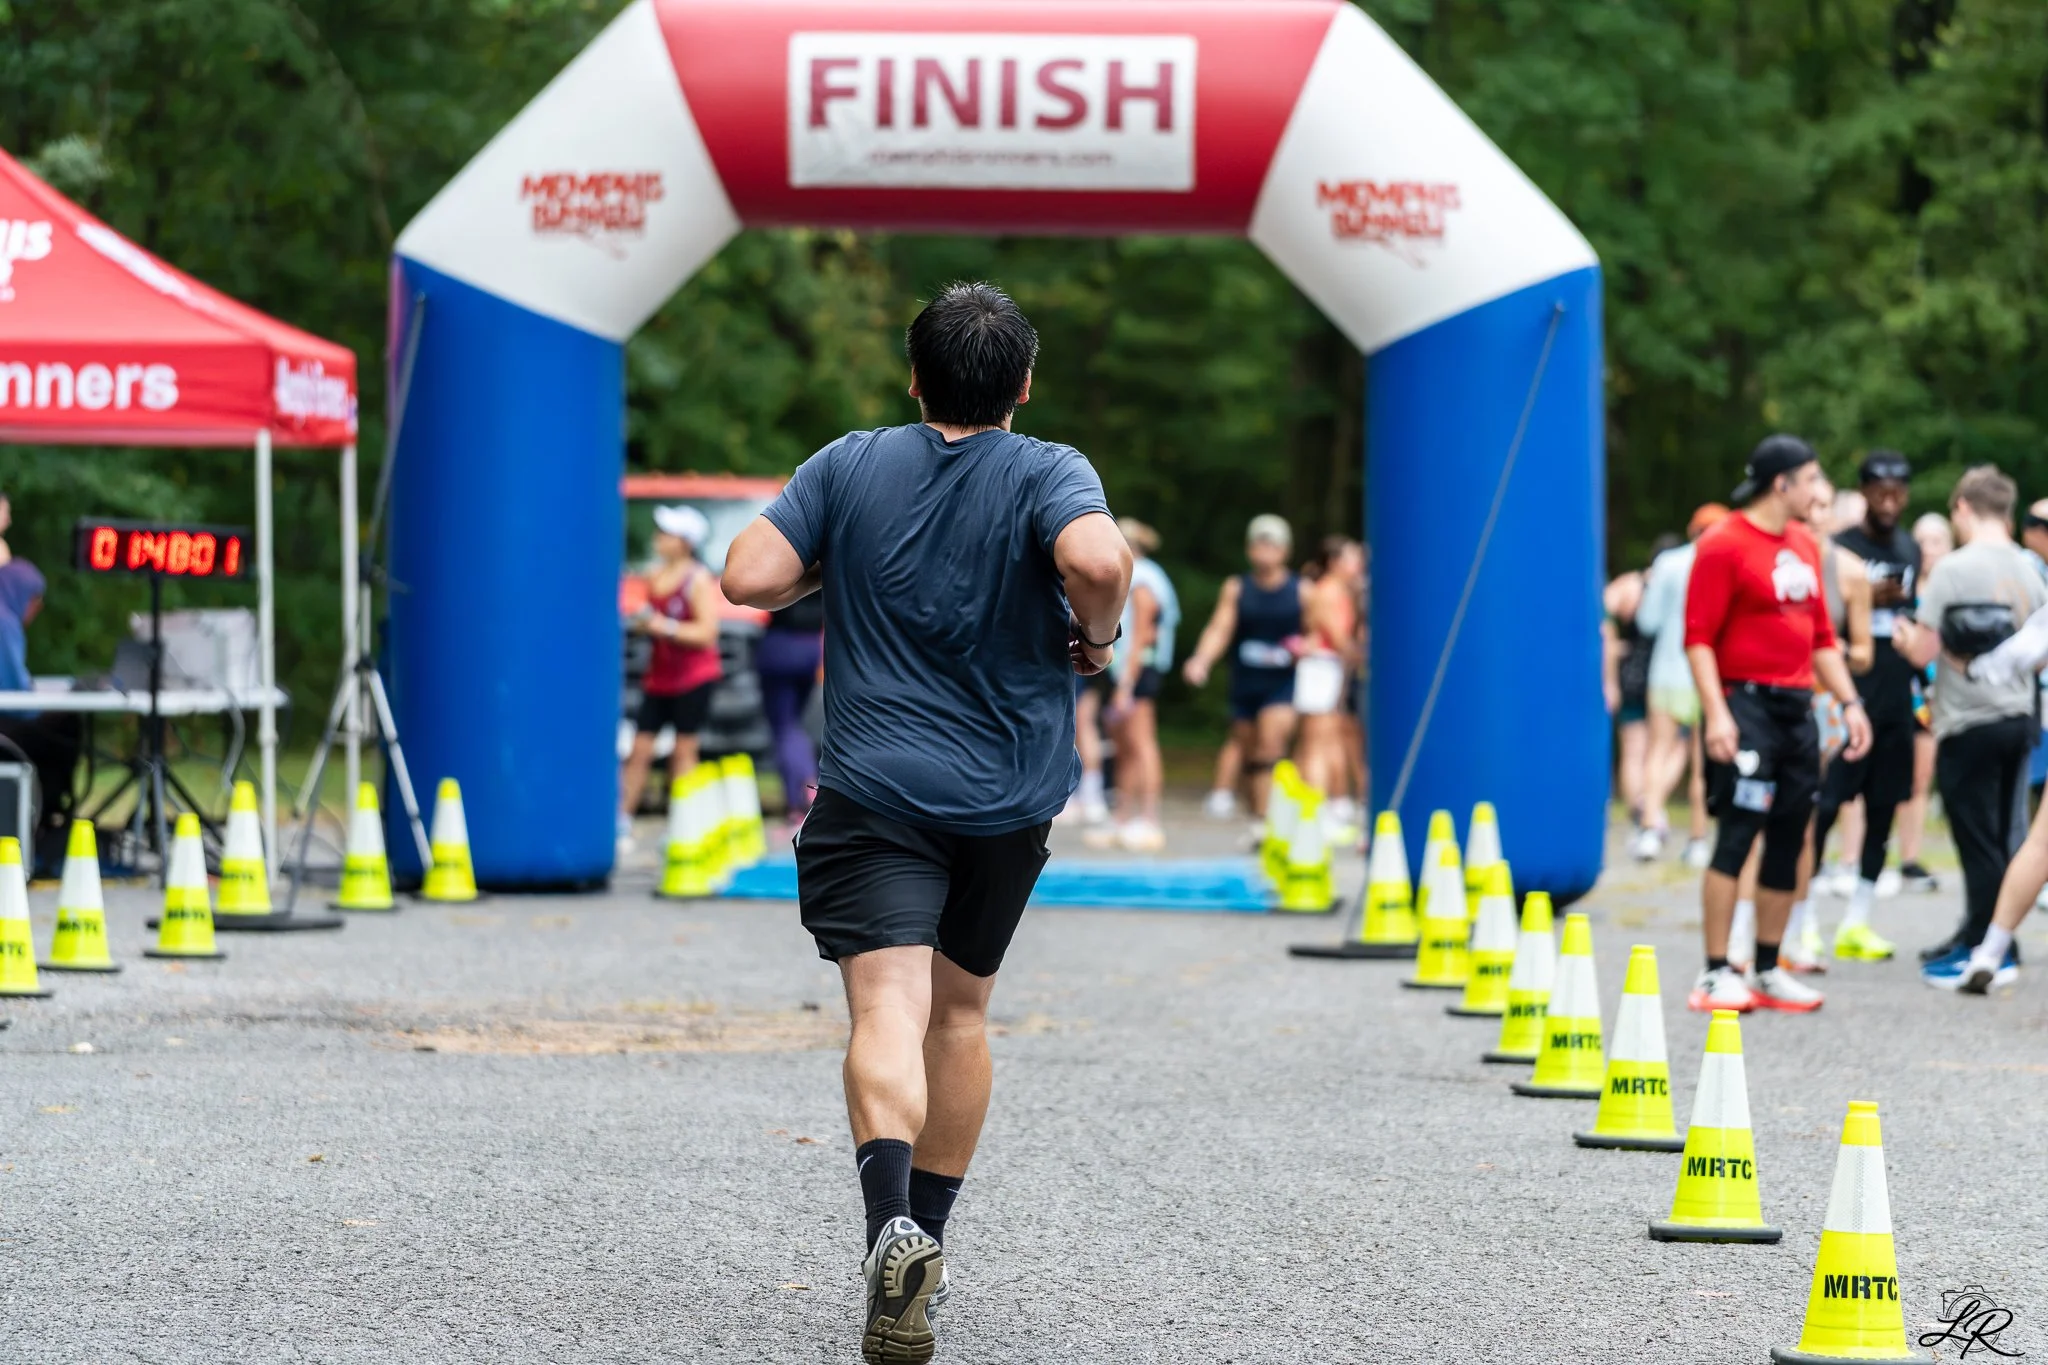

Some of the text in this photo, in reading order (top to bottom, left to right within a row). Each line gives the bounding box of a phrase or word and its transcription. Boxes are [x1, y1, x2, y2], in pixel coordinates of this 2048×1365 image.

[808, 57, 1174, 131] FINISH
[1509, 1003, 1548, 1018] MRT
[1551, 1031, 1602, 1050] MRTC
[1611, 1076, 1668, 1096] MRTC
[1687, 1156, 1752, 1180] MRTC
[1824, 1274, 1898, 1301] MRTC
